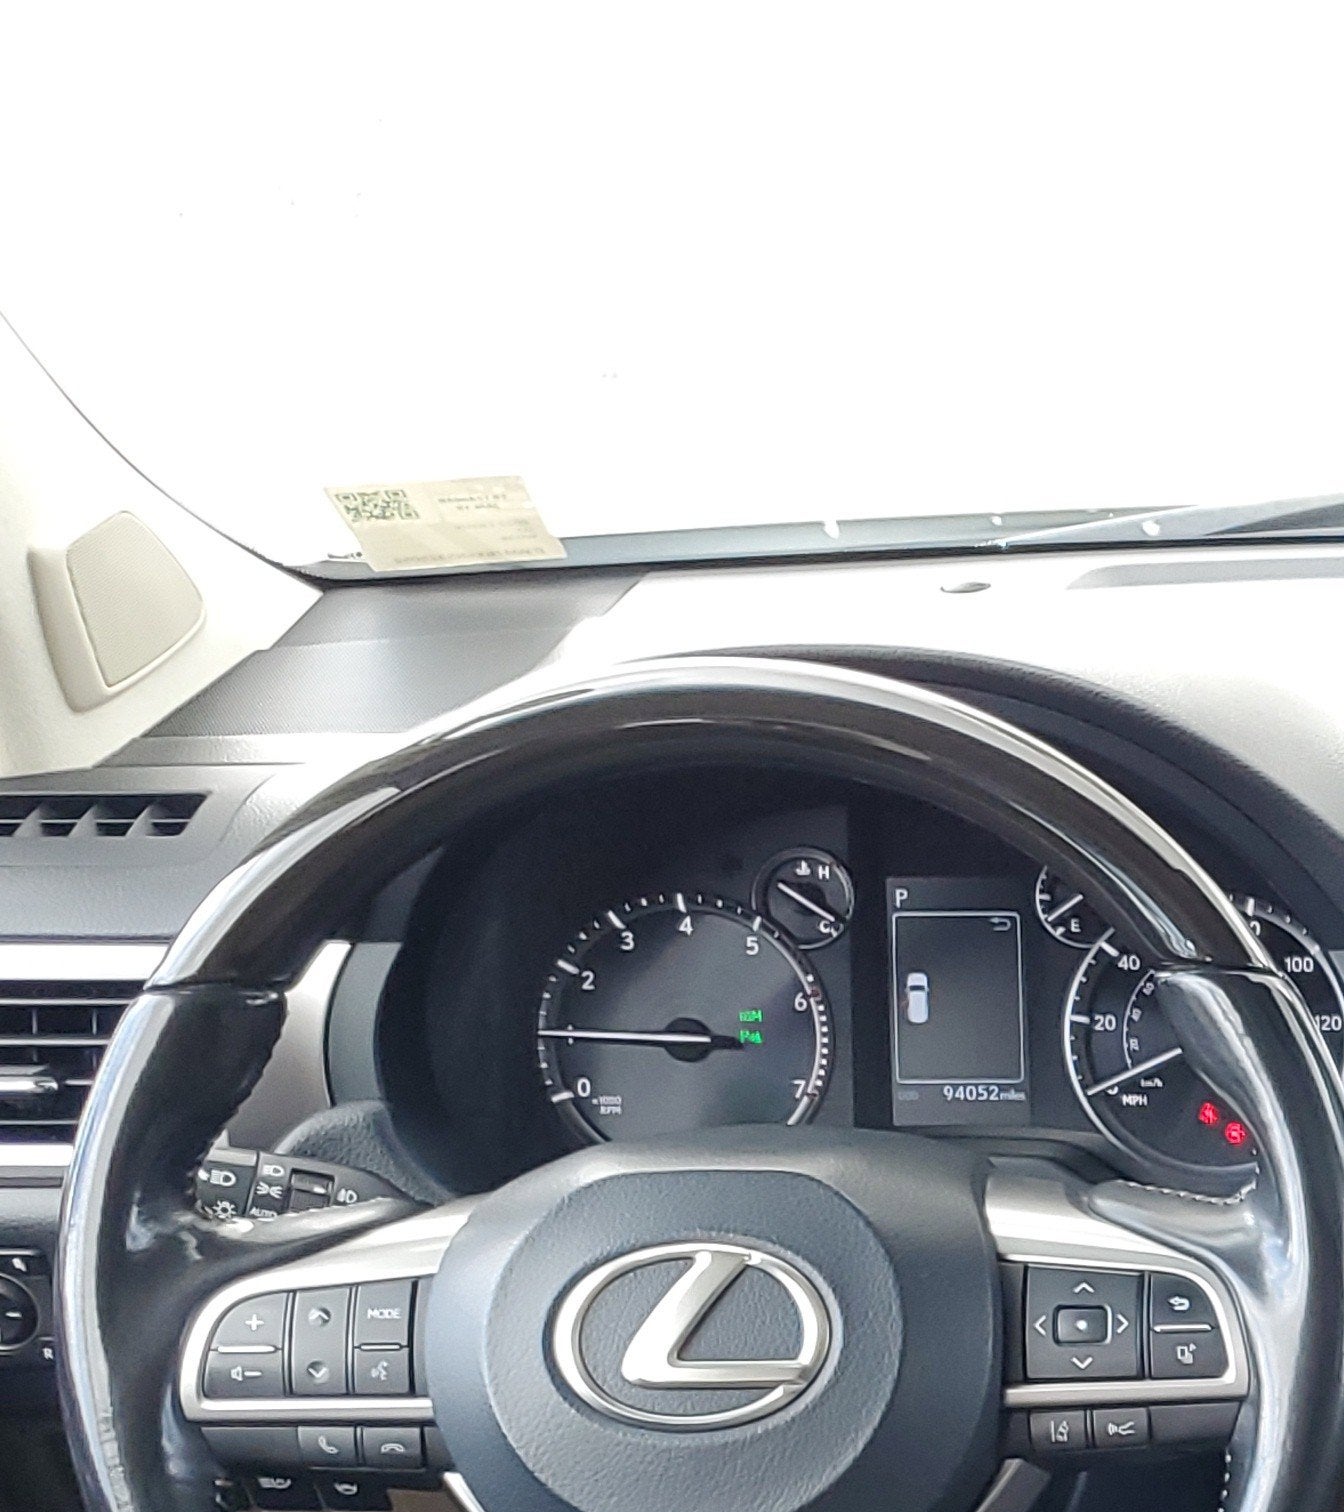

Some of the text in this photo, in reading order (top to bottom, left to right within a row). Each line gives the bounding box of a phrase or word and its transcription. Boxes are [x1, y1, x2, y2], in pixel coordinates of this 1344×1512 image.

[817, 865, 831, 880] H
[895, 888, 909, 908] P
[678, 916, 694, 936] 4
[1070, 918, 1082, 933] E
[620, 931, 636, 951] 3
[745, 937, 760, 956] 5
[1117, 954, 1141, 971] 40
[1284, 956, 1314, 973] 100
[580, 971, 596, 991] 2
[793, 992, 808, 1012] 6
[1094, 1014, 1117, 1031] 20
[1314, 1014, 1343, 1031] 120
[576, 1076, 592, 1098] 0
[791, 1079, 806, 1099] 7
[943, 1084, 1000, 1101] 94052
[1122, 1094, 1148, 1106] MPH
[367, 1307, 401, 1320] MODE
